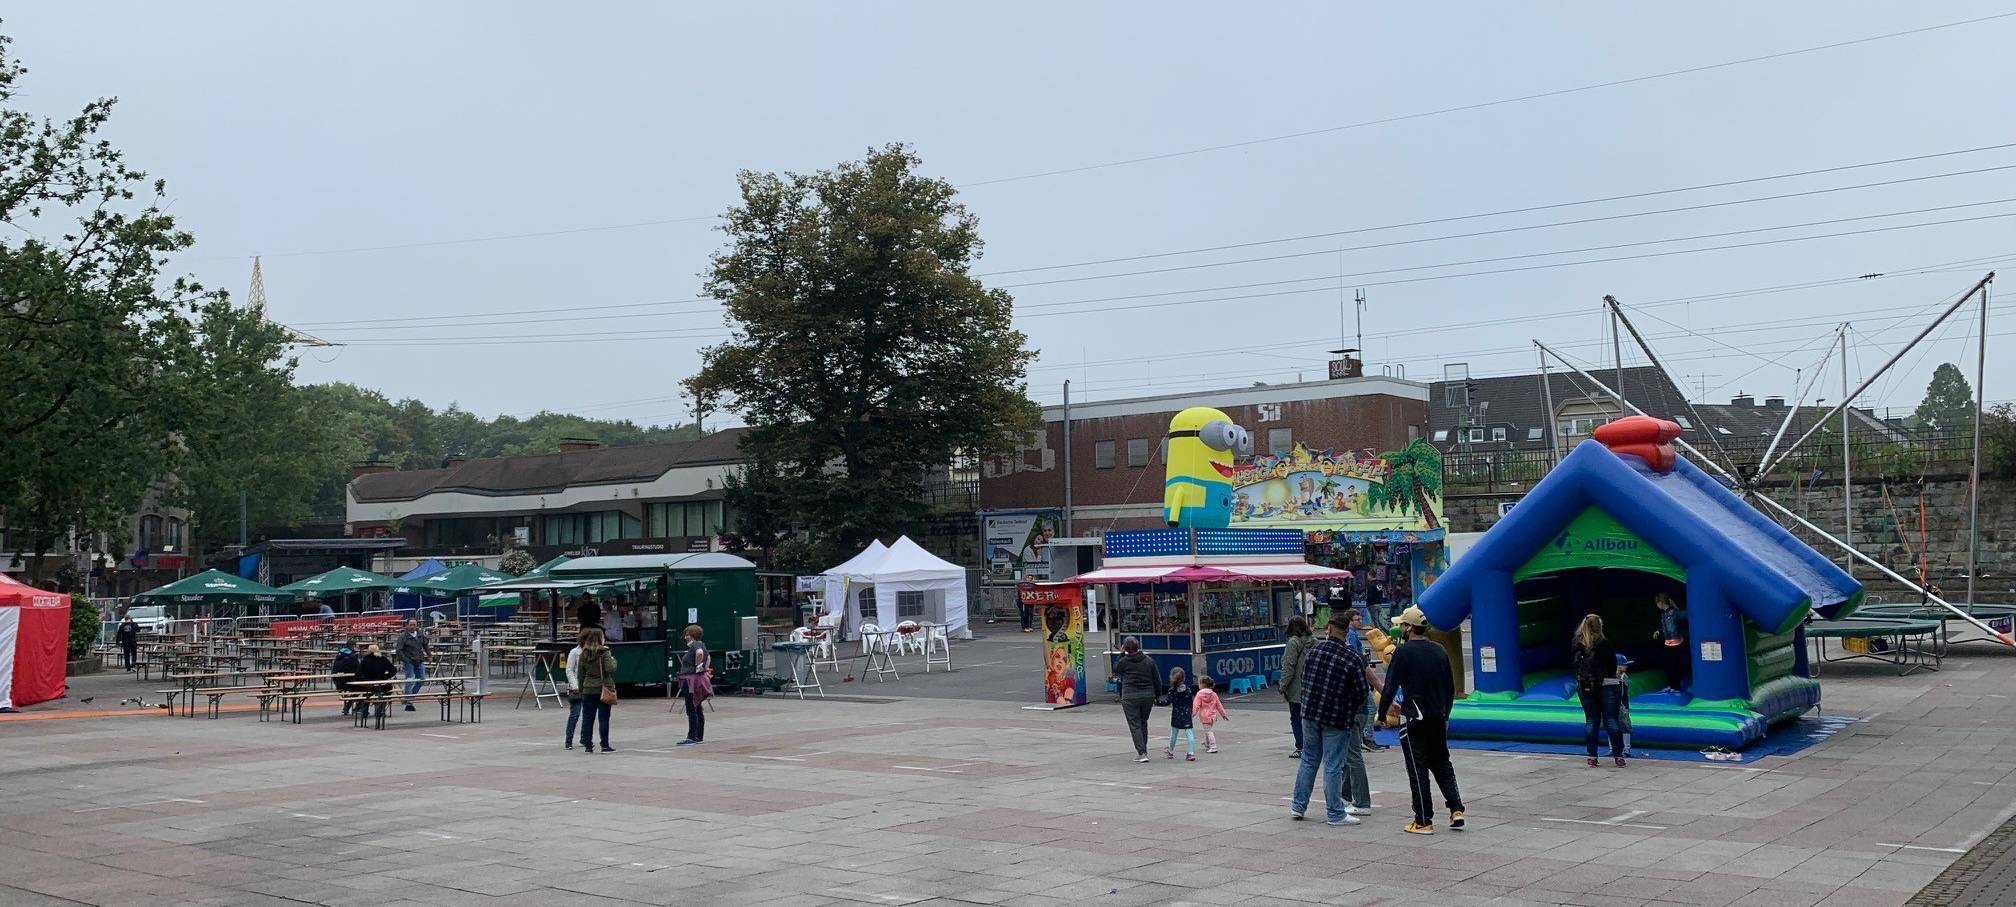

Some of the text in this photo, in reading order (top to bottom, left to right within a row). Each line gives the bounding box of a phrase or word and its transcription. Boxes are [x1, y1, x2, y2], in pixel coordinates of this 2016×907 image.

[1584, 538, 1637, 551] Allbau
[1021, 591, 1054, 600] OXER
[1216, 654, 1281, 676] GOOD LU
